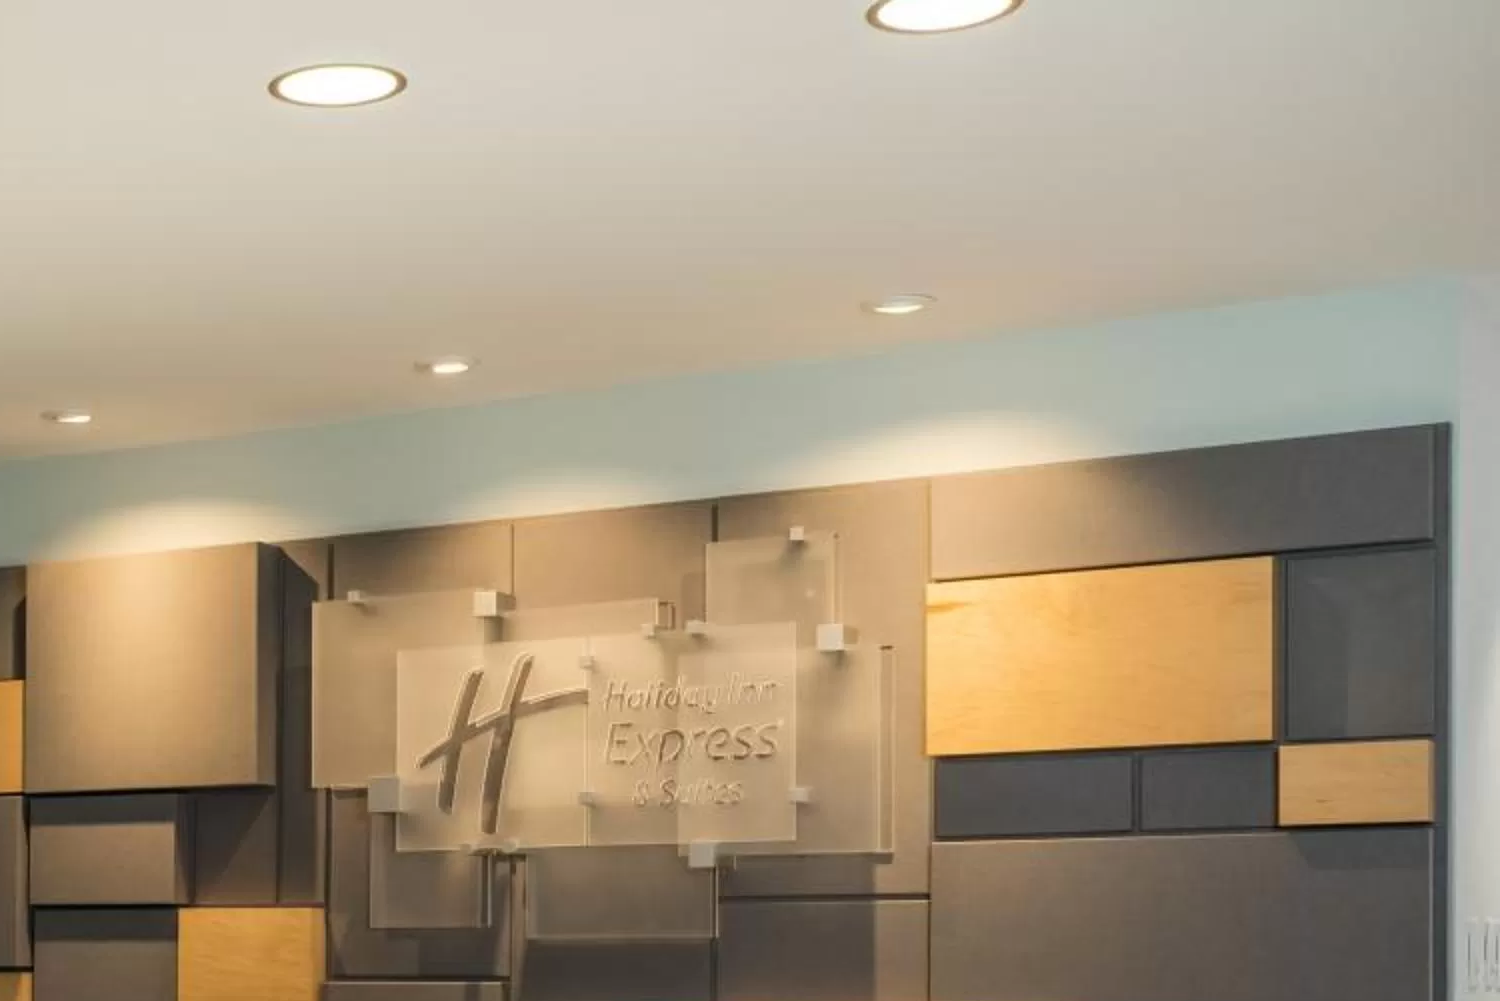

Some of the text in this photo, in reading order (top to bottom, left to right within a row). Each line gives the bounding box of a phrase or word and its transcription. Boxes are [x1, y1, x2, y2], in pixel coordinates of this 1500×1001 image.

[603, 672, 781, 715] Holiday Inn
[605, 721, 780, 771] Express
[659, 779, 743, 807] Suites
